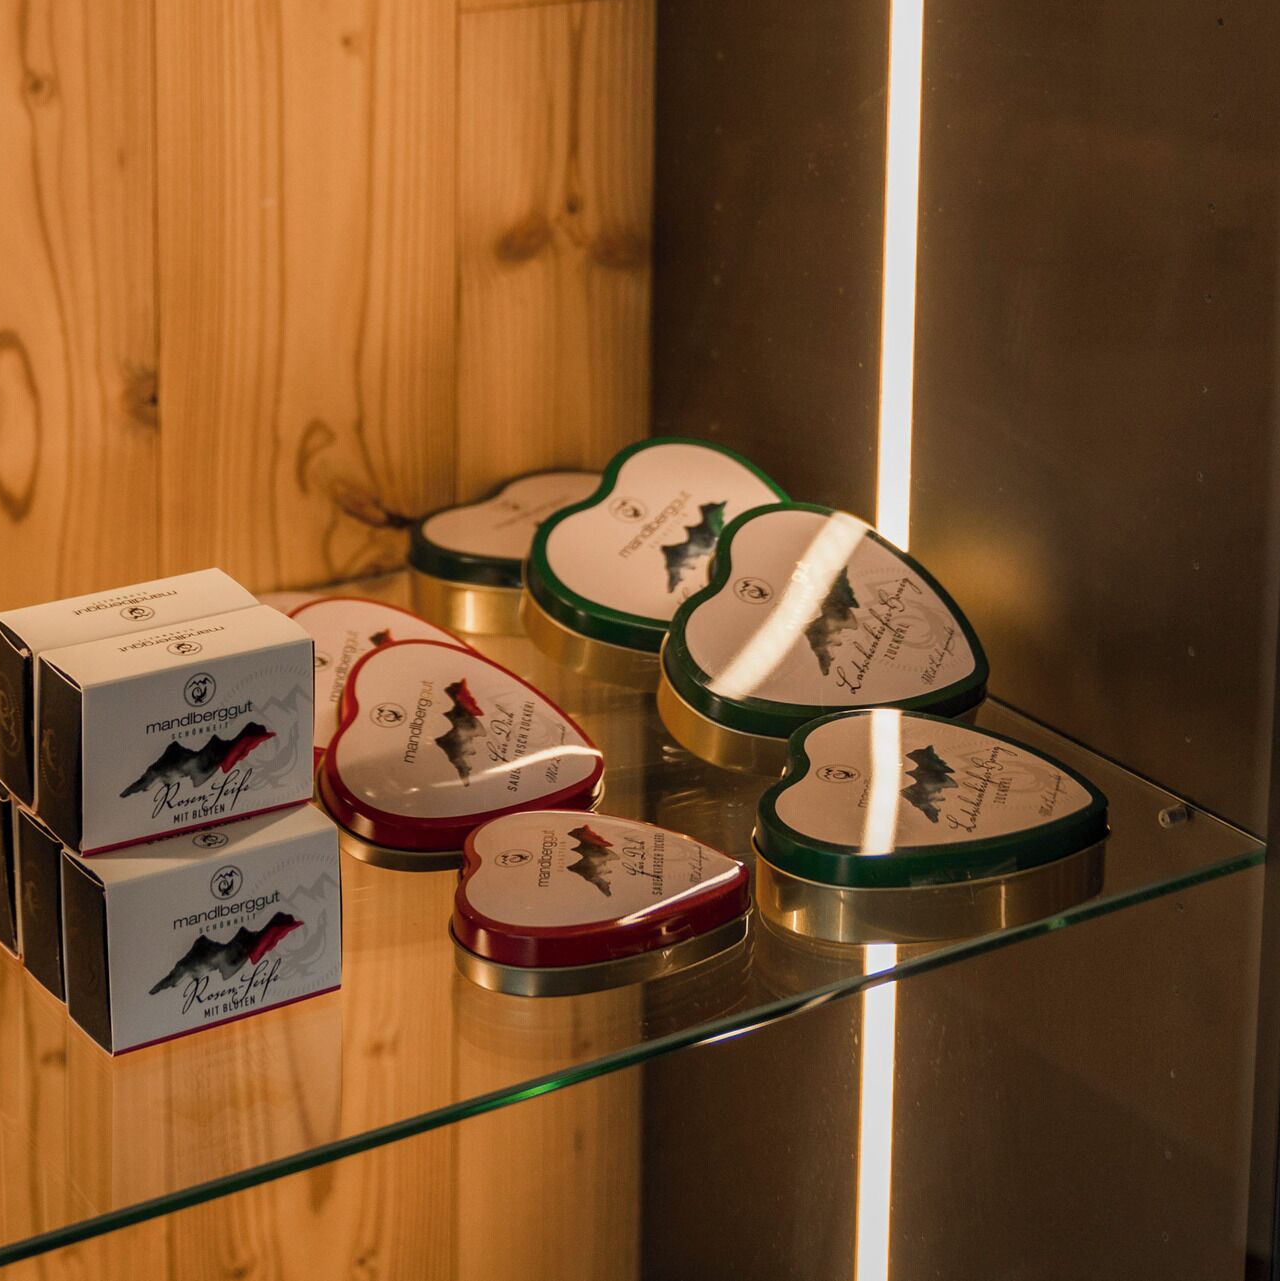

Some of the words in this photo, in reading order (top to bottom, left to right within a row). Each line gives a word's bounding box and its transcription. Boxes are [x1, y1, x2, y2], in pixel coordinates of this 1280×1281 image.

[146, 699, 254, 735] mandlberggut
[404, 681, 434, 764] mandlberggut
[507, 734, 529, 792] SAUEIRSCH
[521, 700, 535, 732] ZUCKERL
[152, 767, 253, 820] Rosen-Seife
[173, 811, 189, 824] MIT
[538, 830, 559, 888] mandlberggut
[173, 890, 280, 930] mandlberggut
[182, 958, 282, 1015] Rosen-Seife
[204, 1006, 219, 1018] MIT
